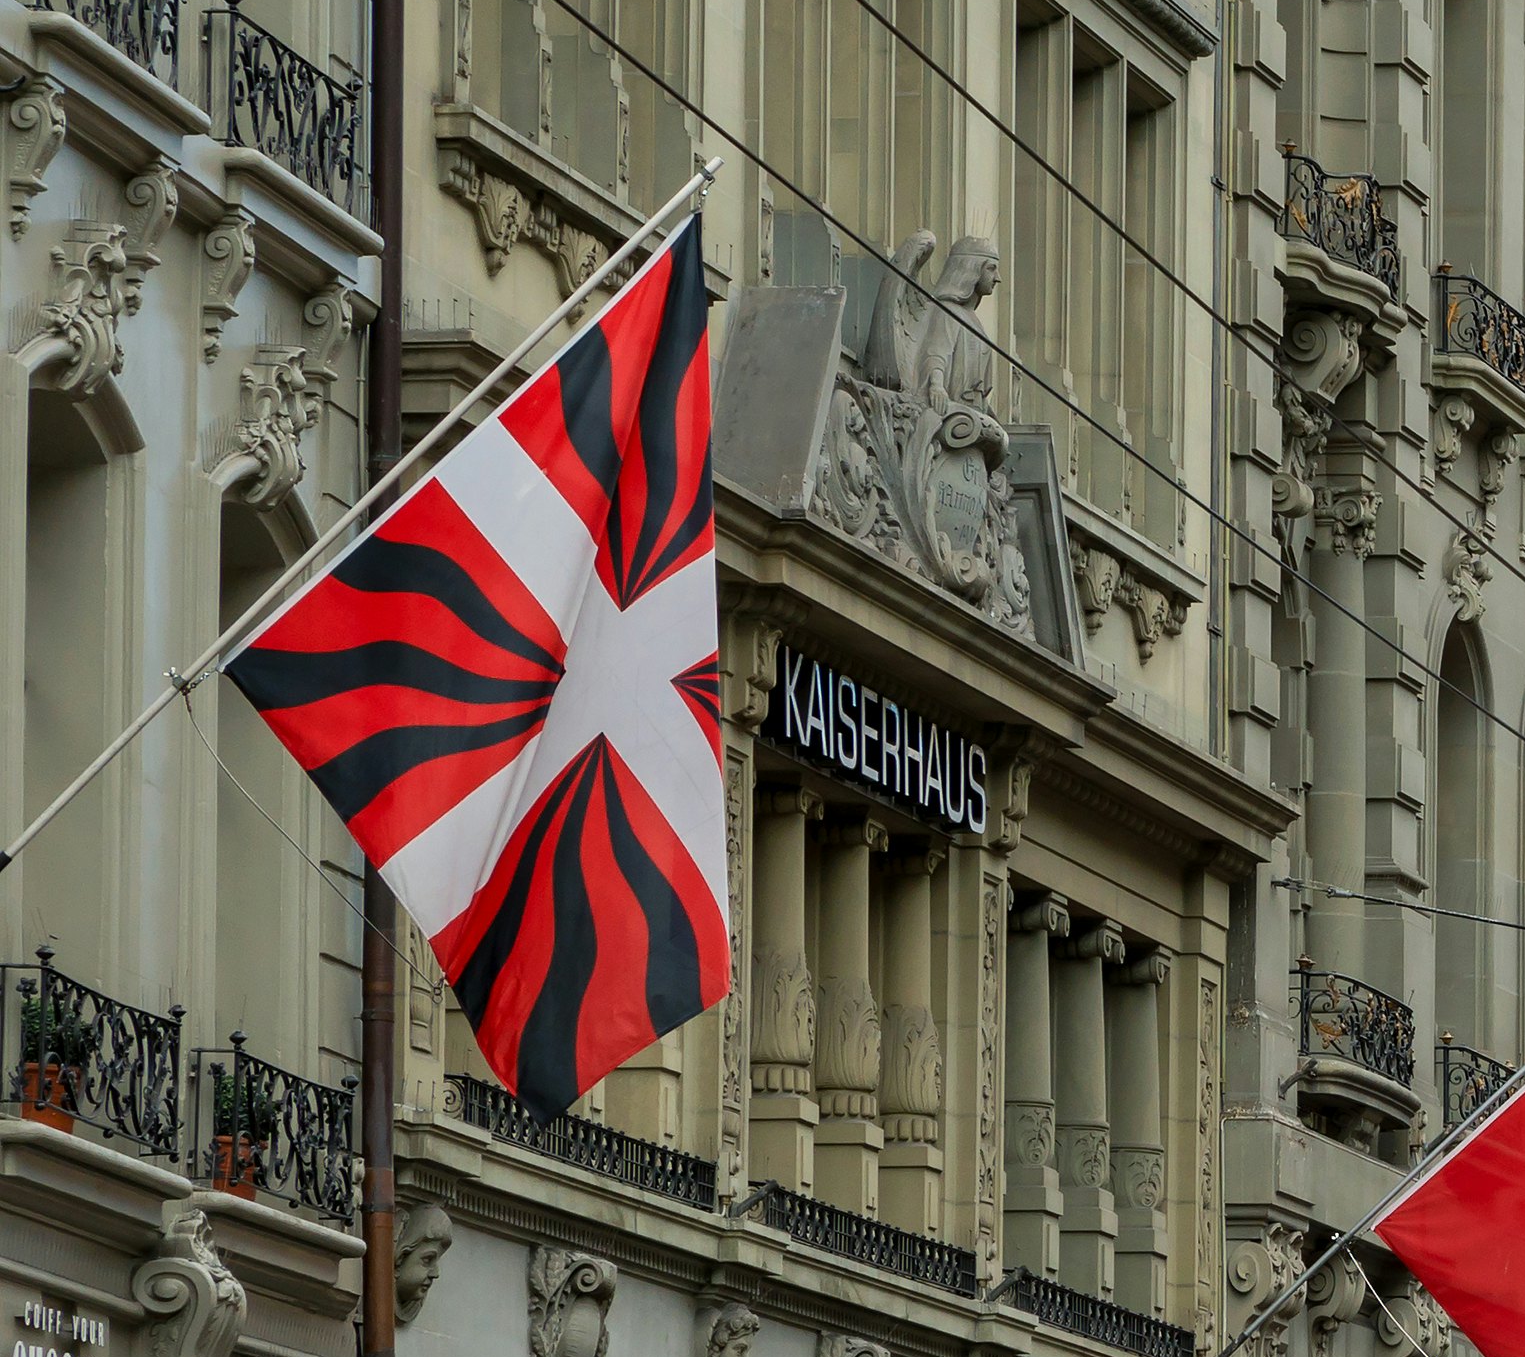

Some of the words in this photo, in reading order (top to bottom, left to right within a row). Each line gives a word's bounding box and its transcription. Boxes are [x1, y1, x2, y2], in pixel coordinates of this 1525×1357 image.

[785, 646, 986, 834] KAISERHAUS
[24, 1300, 61, 1334] COIFF
[73, 1315, 105, 1347] YOUR
